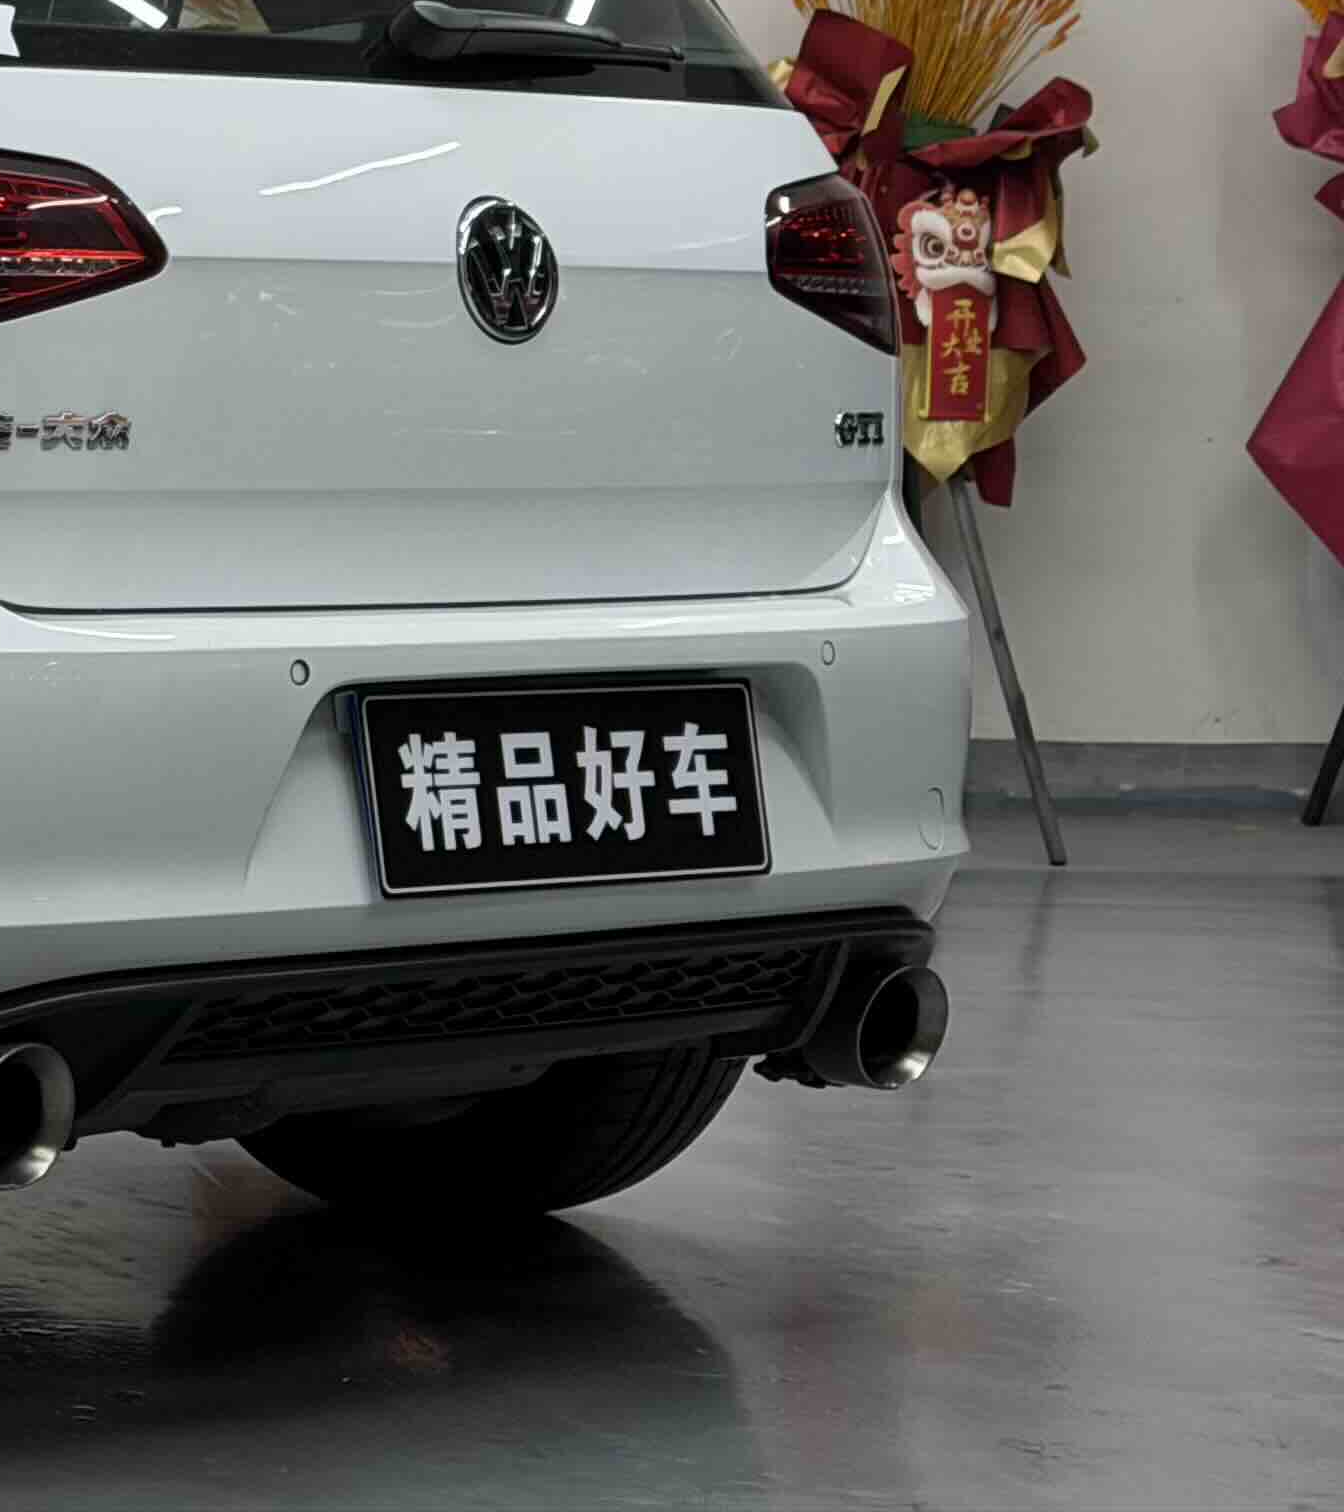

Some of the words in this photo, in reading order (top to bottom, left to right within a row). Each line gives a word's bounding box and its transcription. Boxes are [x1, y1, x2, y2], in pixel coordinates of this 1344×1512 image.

[834, 411, 884, 446] GTI
[397, 722, 737, 852] 精品好车
